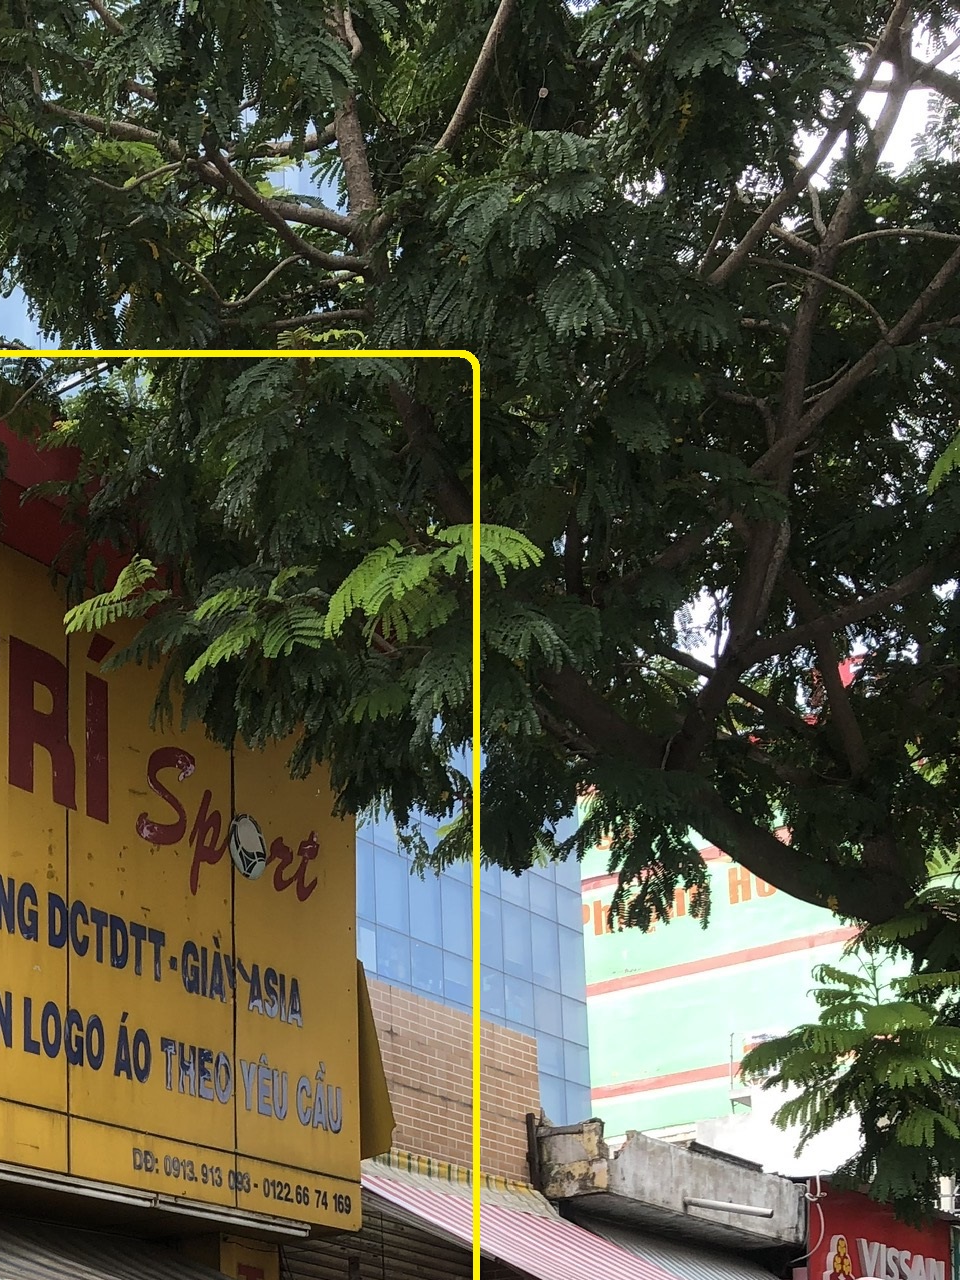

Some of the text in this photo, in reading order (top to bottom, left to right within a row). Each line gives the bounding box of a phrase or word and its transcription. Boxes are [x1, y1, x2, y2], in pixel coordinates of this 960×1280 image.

[47, 892, 166, 982] DCTDTT
[181, 935, 251, 1003] GIÀY
[248, 963, 304, 1028] ASIA
[23, 996, 104, 1071] LOGO
[114, 1011, 152, 1084] ÁO
[160, 1036, 233, 1104] THEO
[240, 1053, 288, 1121] YÊU
[296, 1061, 343, 1134] CẦU
[132, 1147, 160, 1174] DĐ:
[201, 1163, 223, 1188] 913
[315, 1189, 328, 1211] 74
[333, 1193, 352, 1215] 169
